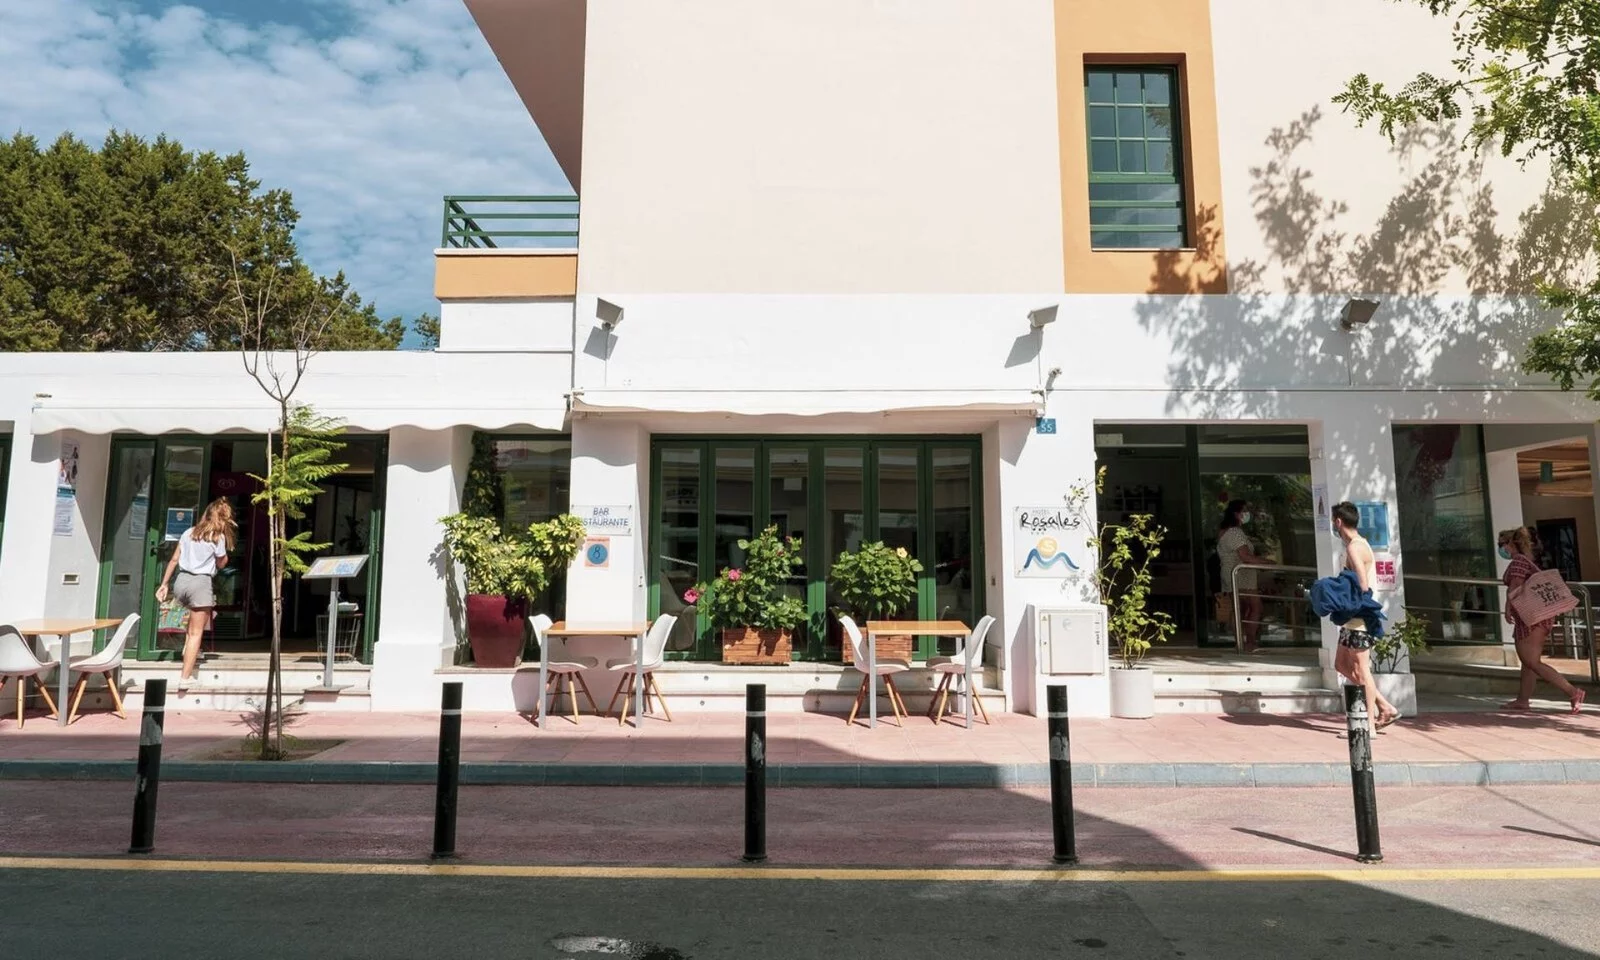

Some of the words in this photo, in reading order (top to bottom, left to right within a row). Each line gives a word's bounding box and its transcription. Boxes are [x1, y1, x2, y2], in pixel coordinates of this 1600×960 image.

[1041, 424, 1053, 433] 55
[593, 507, 610, 516] BAR
[583, 517, 629, 527] STAURANTE
[1020, 512, 1081, 528] Rosales
